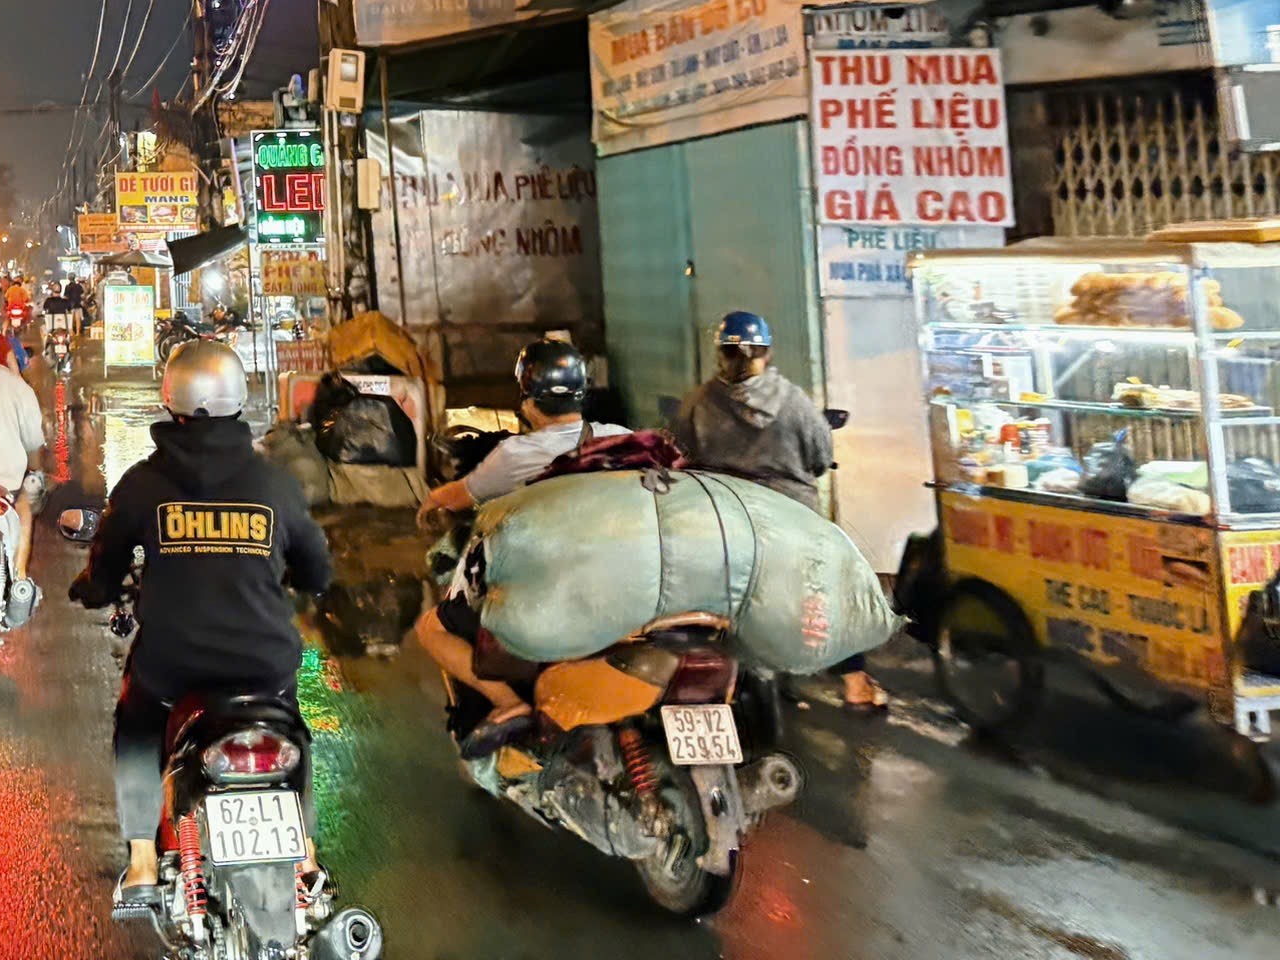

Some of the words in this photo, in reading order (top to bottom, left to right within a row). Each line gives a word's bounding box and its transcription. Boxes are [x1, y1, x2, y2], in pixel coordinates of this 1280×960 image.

[815, 55, 894, 87] THU
[906, 54, 998, 86] MUA
[820, 89, 898, 130] PHẾ
[911, 89, 1001, 137] LIỆU
[258, 137, 309, 170] QUẢNG
[822, 134, 904, 177] ĐỒNG
[913, 136, 1006, 178] NHÔM
[824, 183, 899, 222] GIÁ
[916, 189, 1007, 223] CAO
[166, 505, 268, 542] ÖHLINS
[673, 709, 725, 733] 59-V2
[216, 826, 301, 859] 102.13
